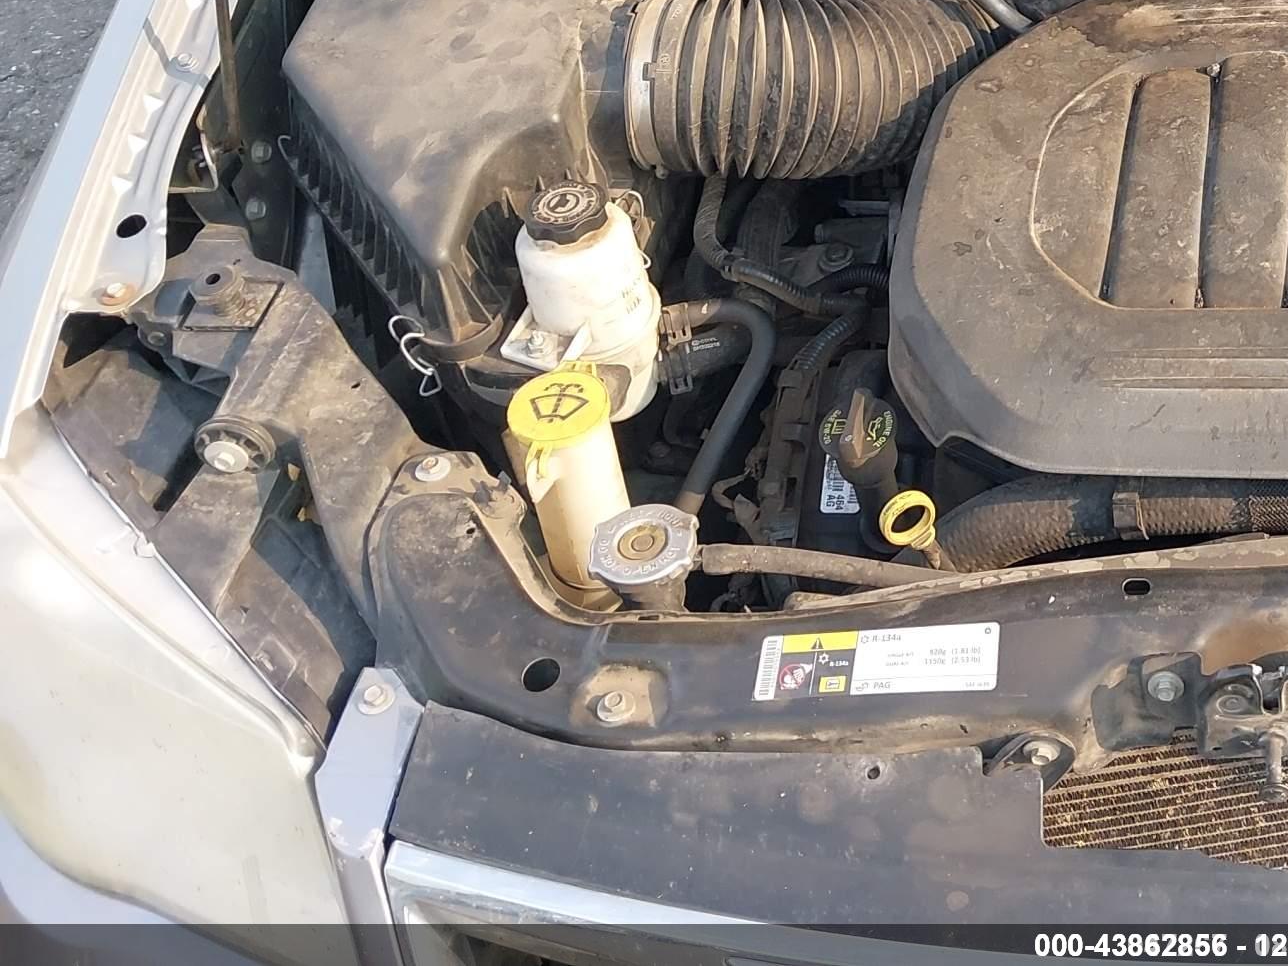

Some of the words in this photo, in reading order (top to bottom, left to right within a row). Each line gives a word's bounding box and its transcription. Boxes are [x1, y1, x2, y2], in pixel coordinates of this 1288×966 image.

[882, 410, 894, 436] ENGINE
[872, 436, 887, 448] OIL
[873, 681, 891, 690] PAG
